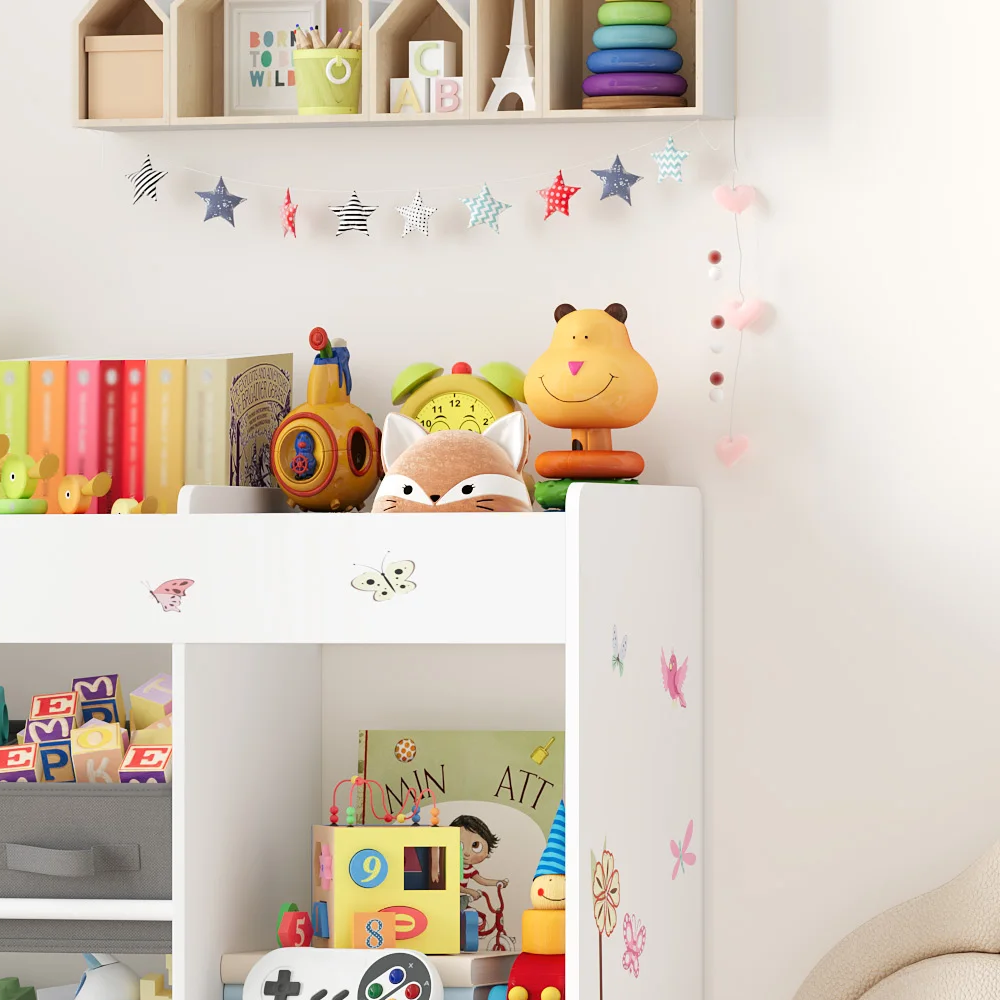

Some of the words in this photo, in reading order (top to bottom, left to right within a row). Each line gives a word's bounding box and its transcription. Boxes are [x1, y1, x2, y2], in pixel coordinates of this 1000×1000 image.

[249, 50, 272, 67] TO
[414, 42, 439, 76] C
[250, 70, 296, 87] WILD
[392, 80, 422, 113] A
[435, 79, 460, 113] B
[432, 405, 442, 413] 11
[420, 420, 432, 428] 10
[34, 695, 73, 716] E
[40, 749, 69, 780] P
[86, 757, 112, 783] K
[124, 747, 169, 767] E
[385, 764, 445, 814] MIN
[493, 765, 554, 810] ATT
[361, 855, 381, 883] 9
[294, 916, 306, 947] 5
[366, 918, 383, 948] 8
